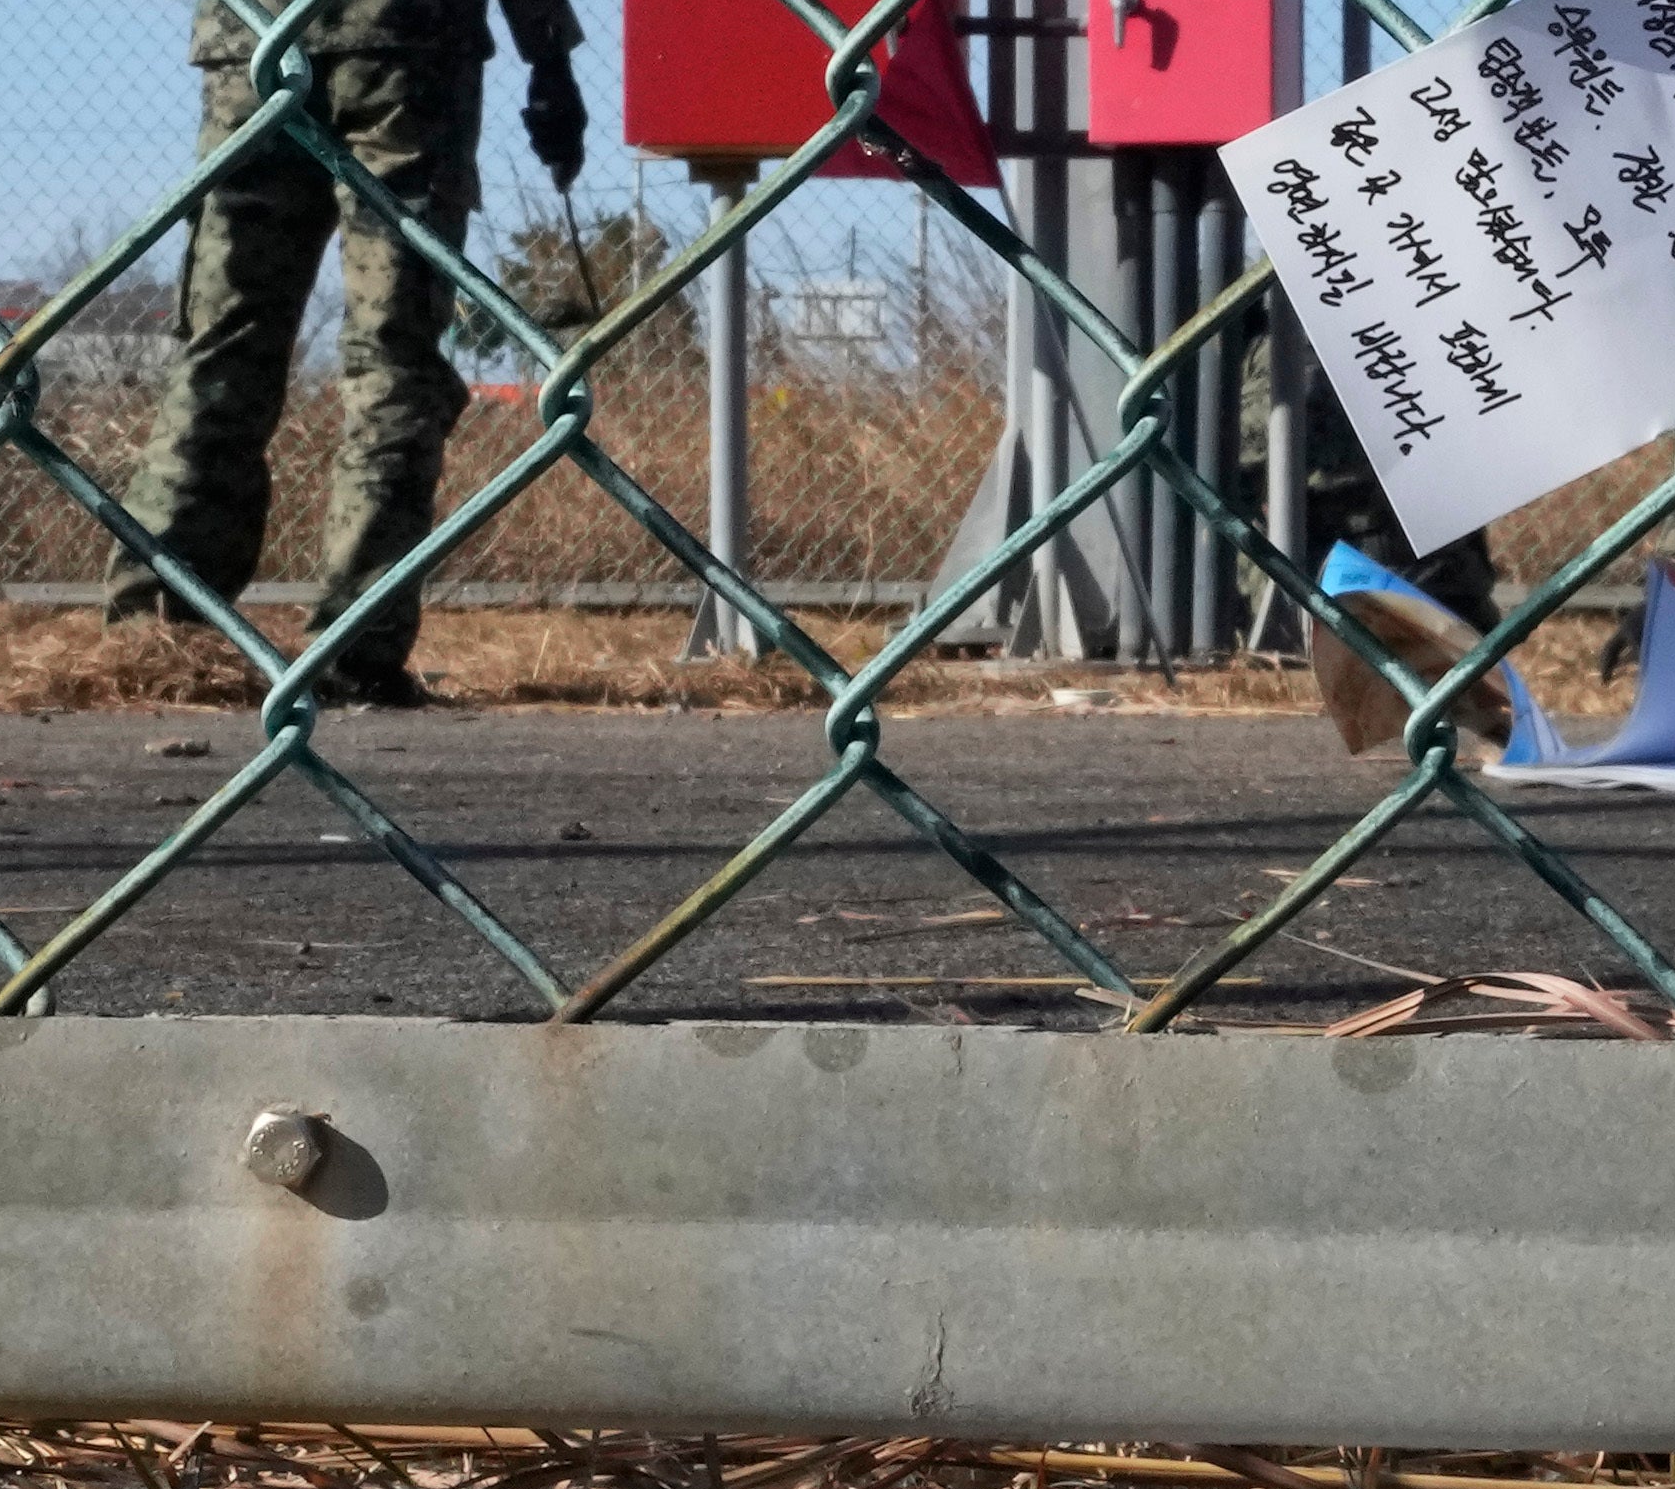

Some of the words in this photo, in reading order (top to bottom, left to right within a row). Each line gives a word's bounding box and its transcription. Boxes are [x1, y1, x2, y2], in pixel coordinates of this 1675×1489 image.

[1410, 77, 1471, 142] 고생
[1613, 144, 1674, 214] 정말
[1330, 106, 1379, 167] 좋은
[1358, 169, 1401, 206] 곳
[1387, 212, 1460, 308] 가셔서
[1439, 321, 1522, 415] 편하게
[1558, 204, 1612, 277] 모두
[1351, 321, 1445, 456] 바랍니다.
